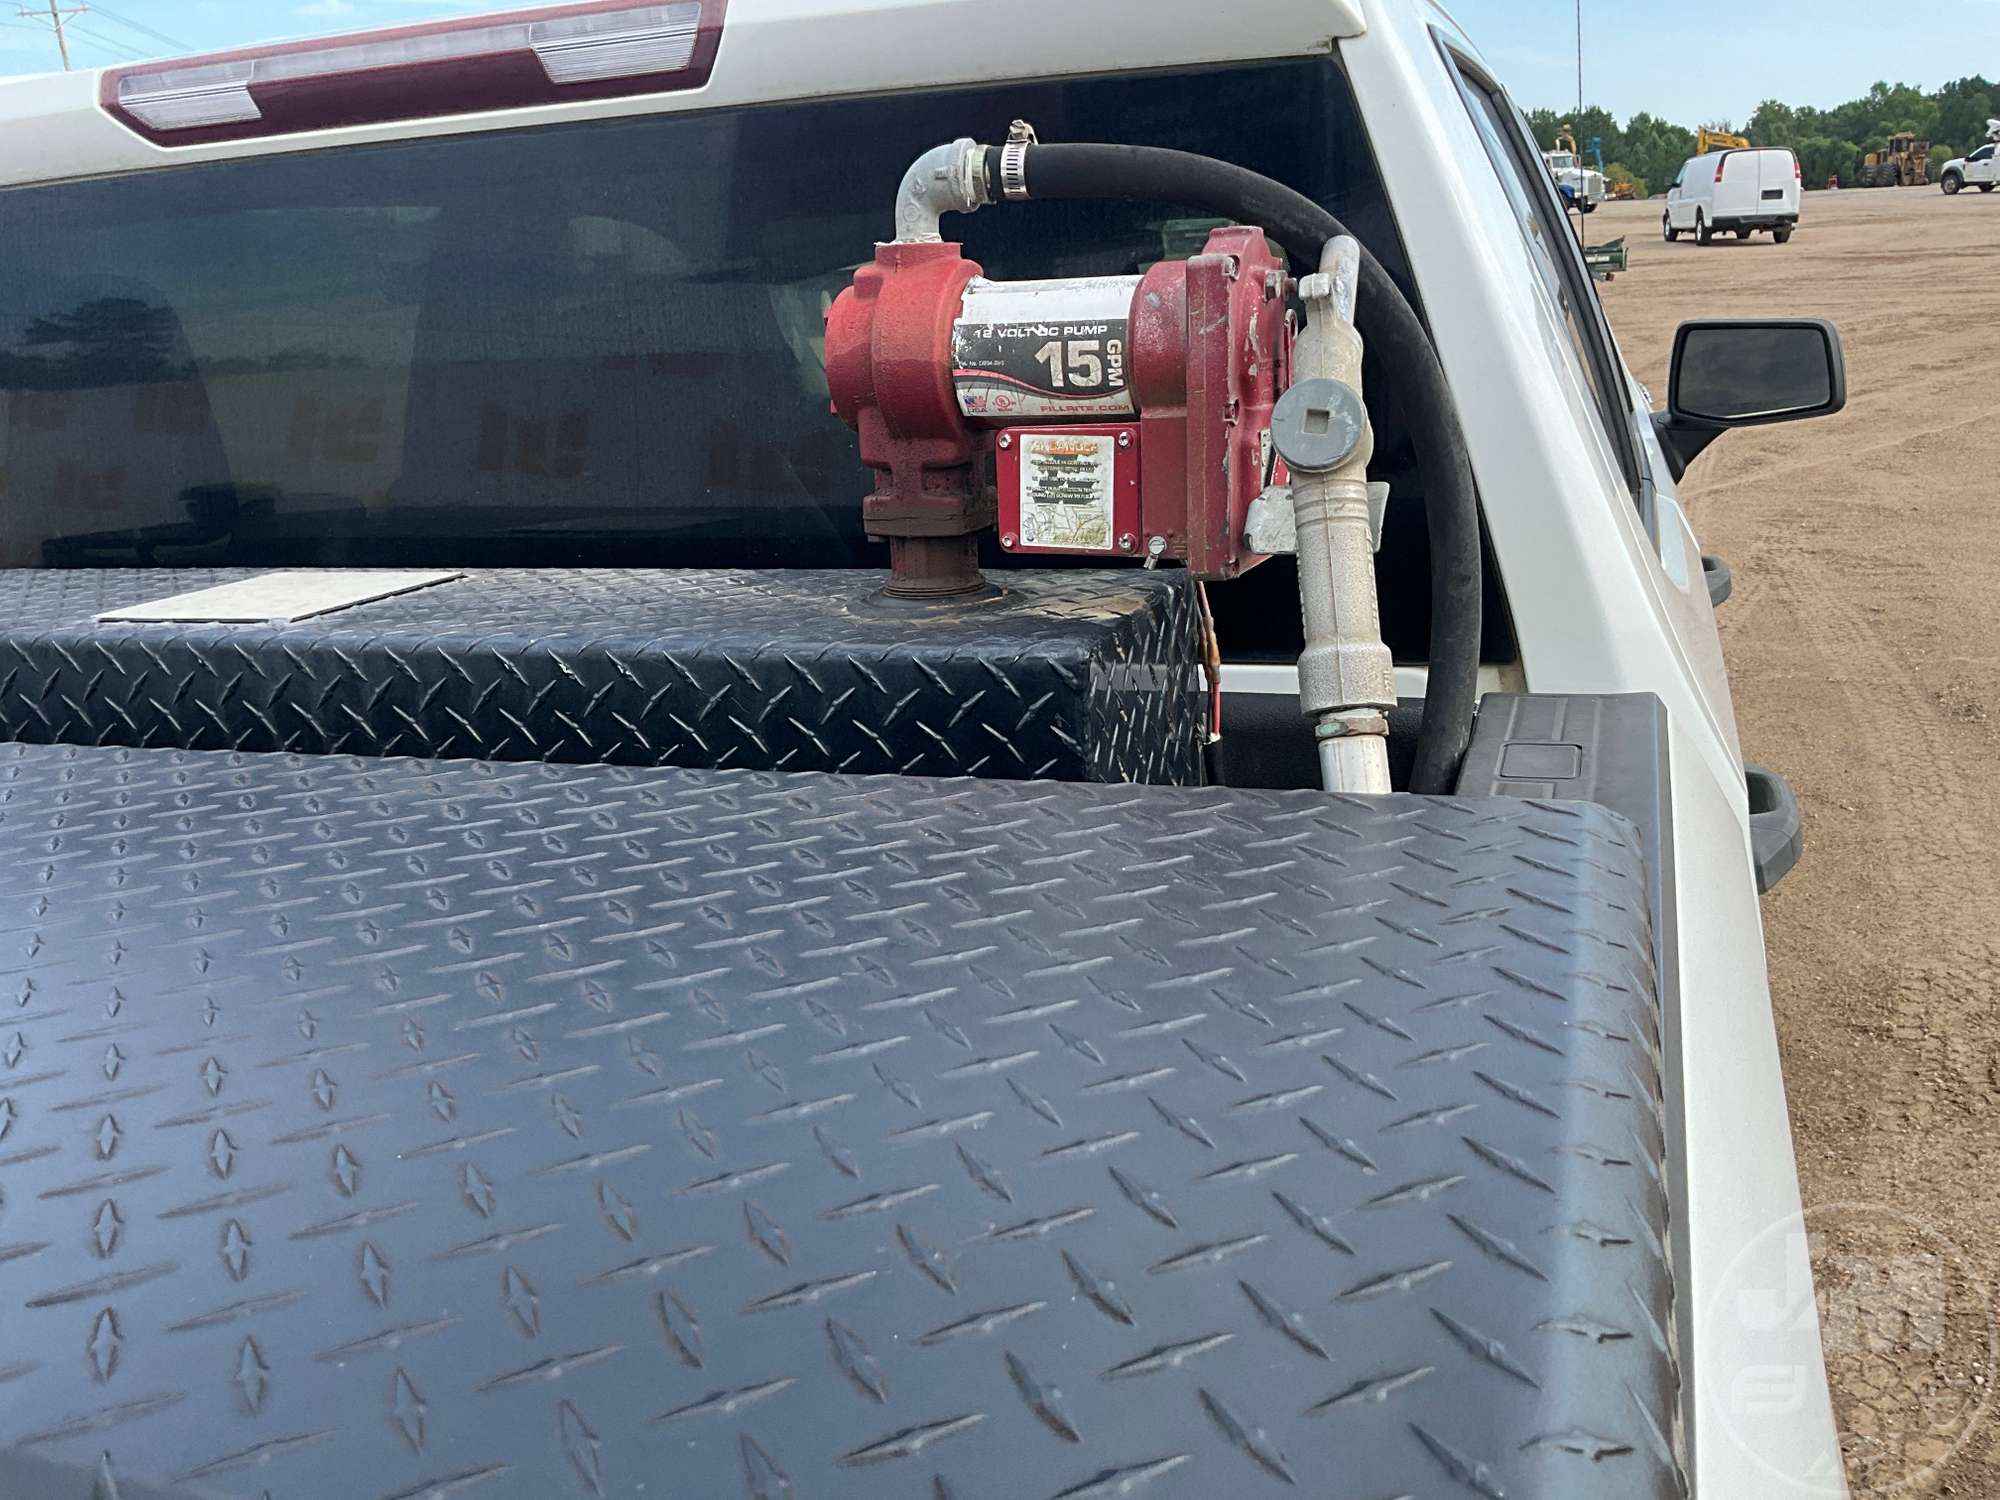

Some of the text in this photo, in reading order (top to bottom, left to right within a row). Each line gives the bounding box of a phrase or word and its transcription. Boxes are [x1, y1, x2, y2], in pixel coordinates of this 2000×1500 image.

[996, 328, 1031, 338] VOLT
[1064, 325, 1108, 335] PUMP
[1034, 340, 1102, 387] 15
[1106, 339, 1124, 387] GPM
[1039, 404, 1130, 412] FILLRITE.COM
